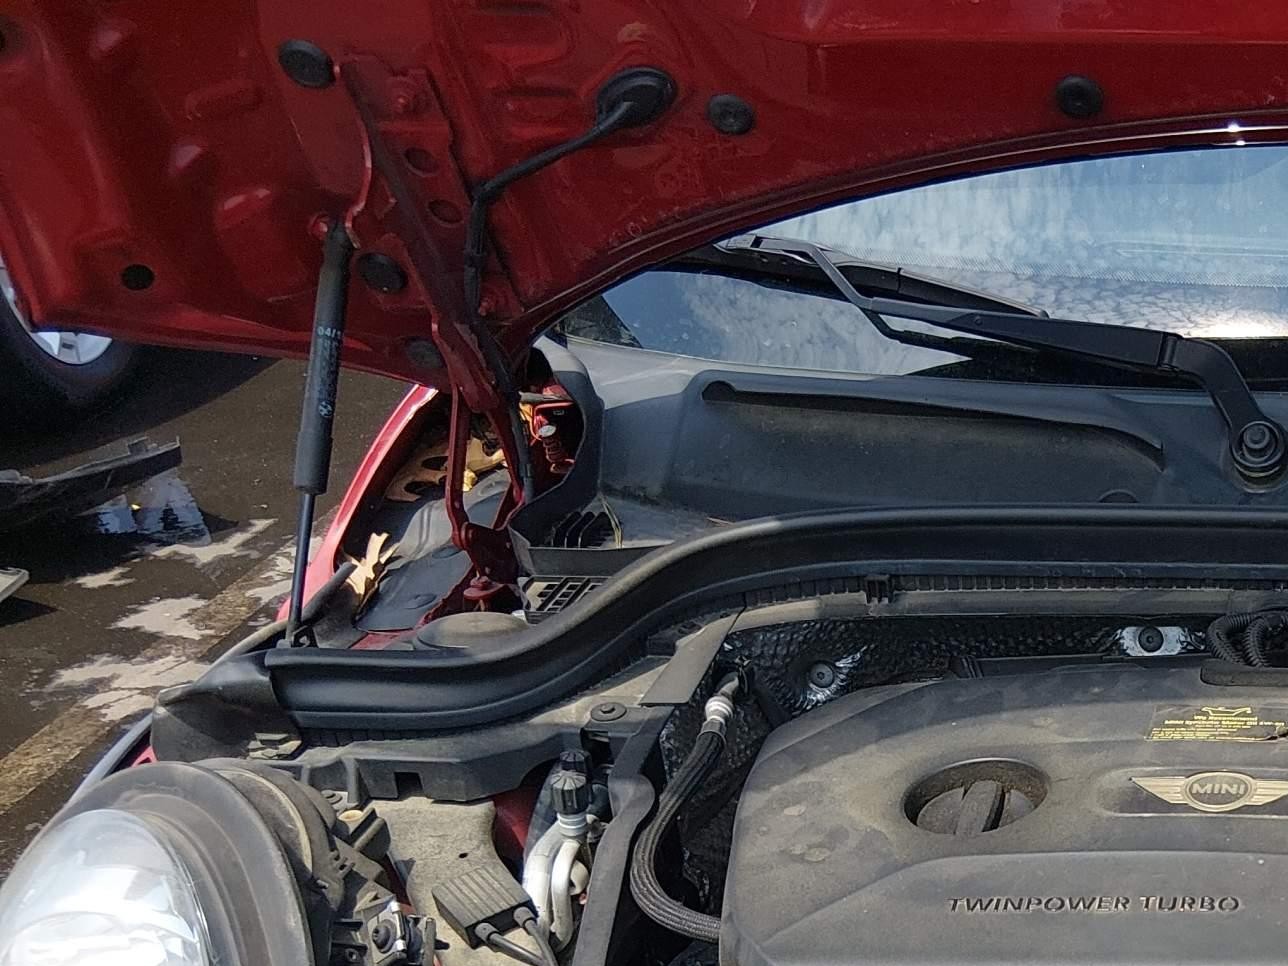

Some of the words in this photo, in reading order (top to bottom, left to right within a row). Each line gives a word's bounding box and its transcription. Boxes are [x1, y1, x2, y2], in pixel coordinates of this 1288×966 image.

[1191, 784, 1245, 795] MINI
[947, 896, 1131, 913] TWINPOWER
[1140, 896, 1241, 913] TURBO
